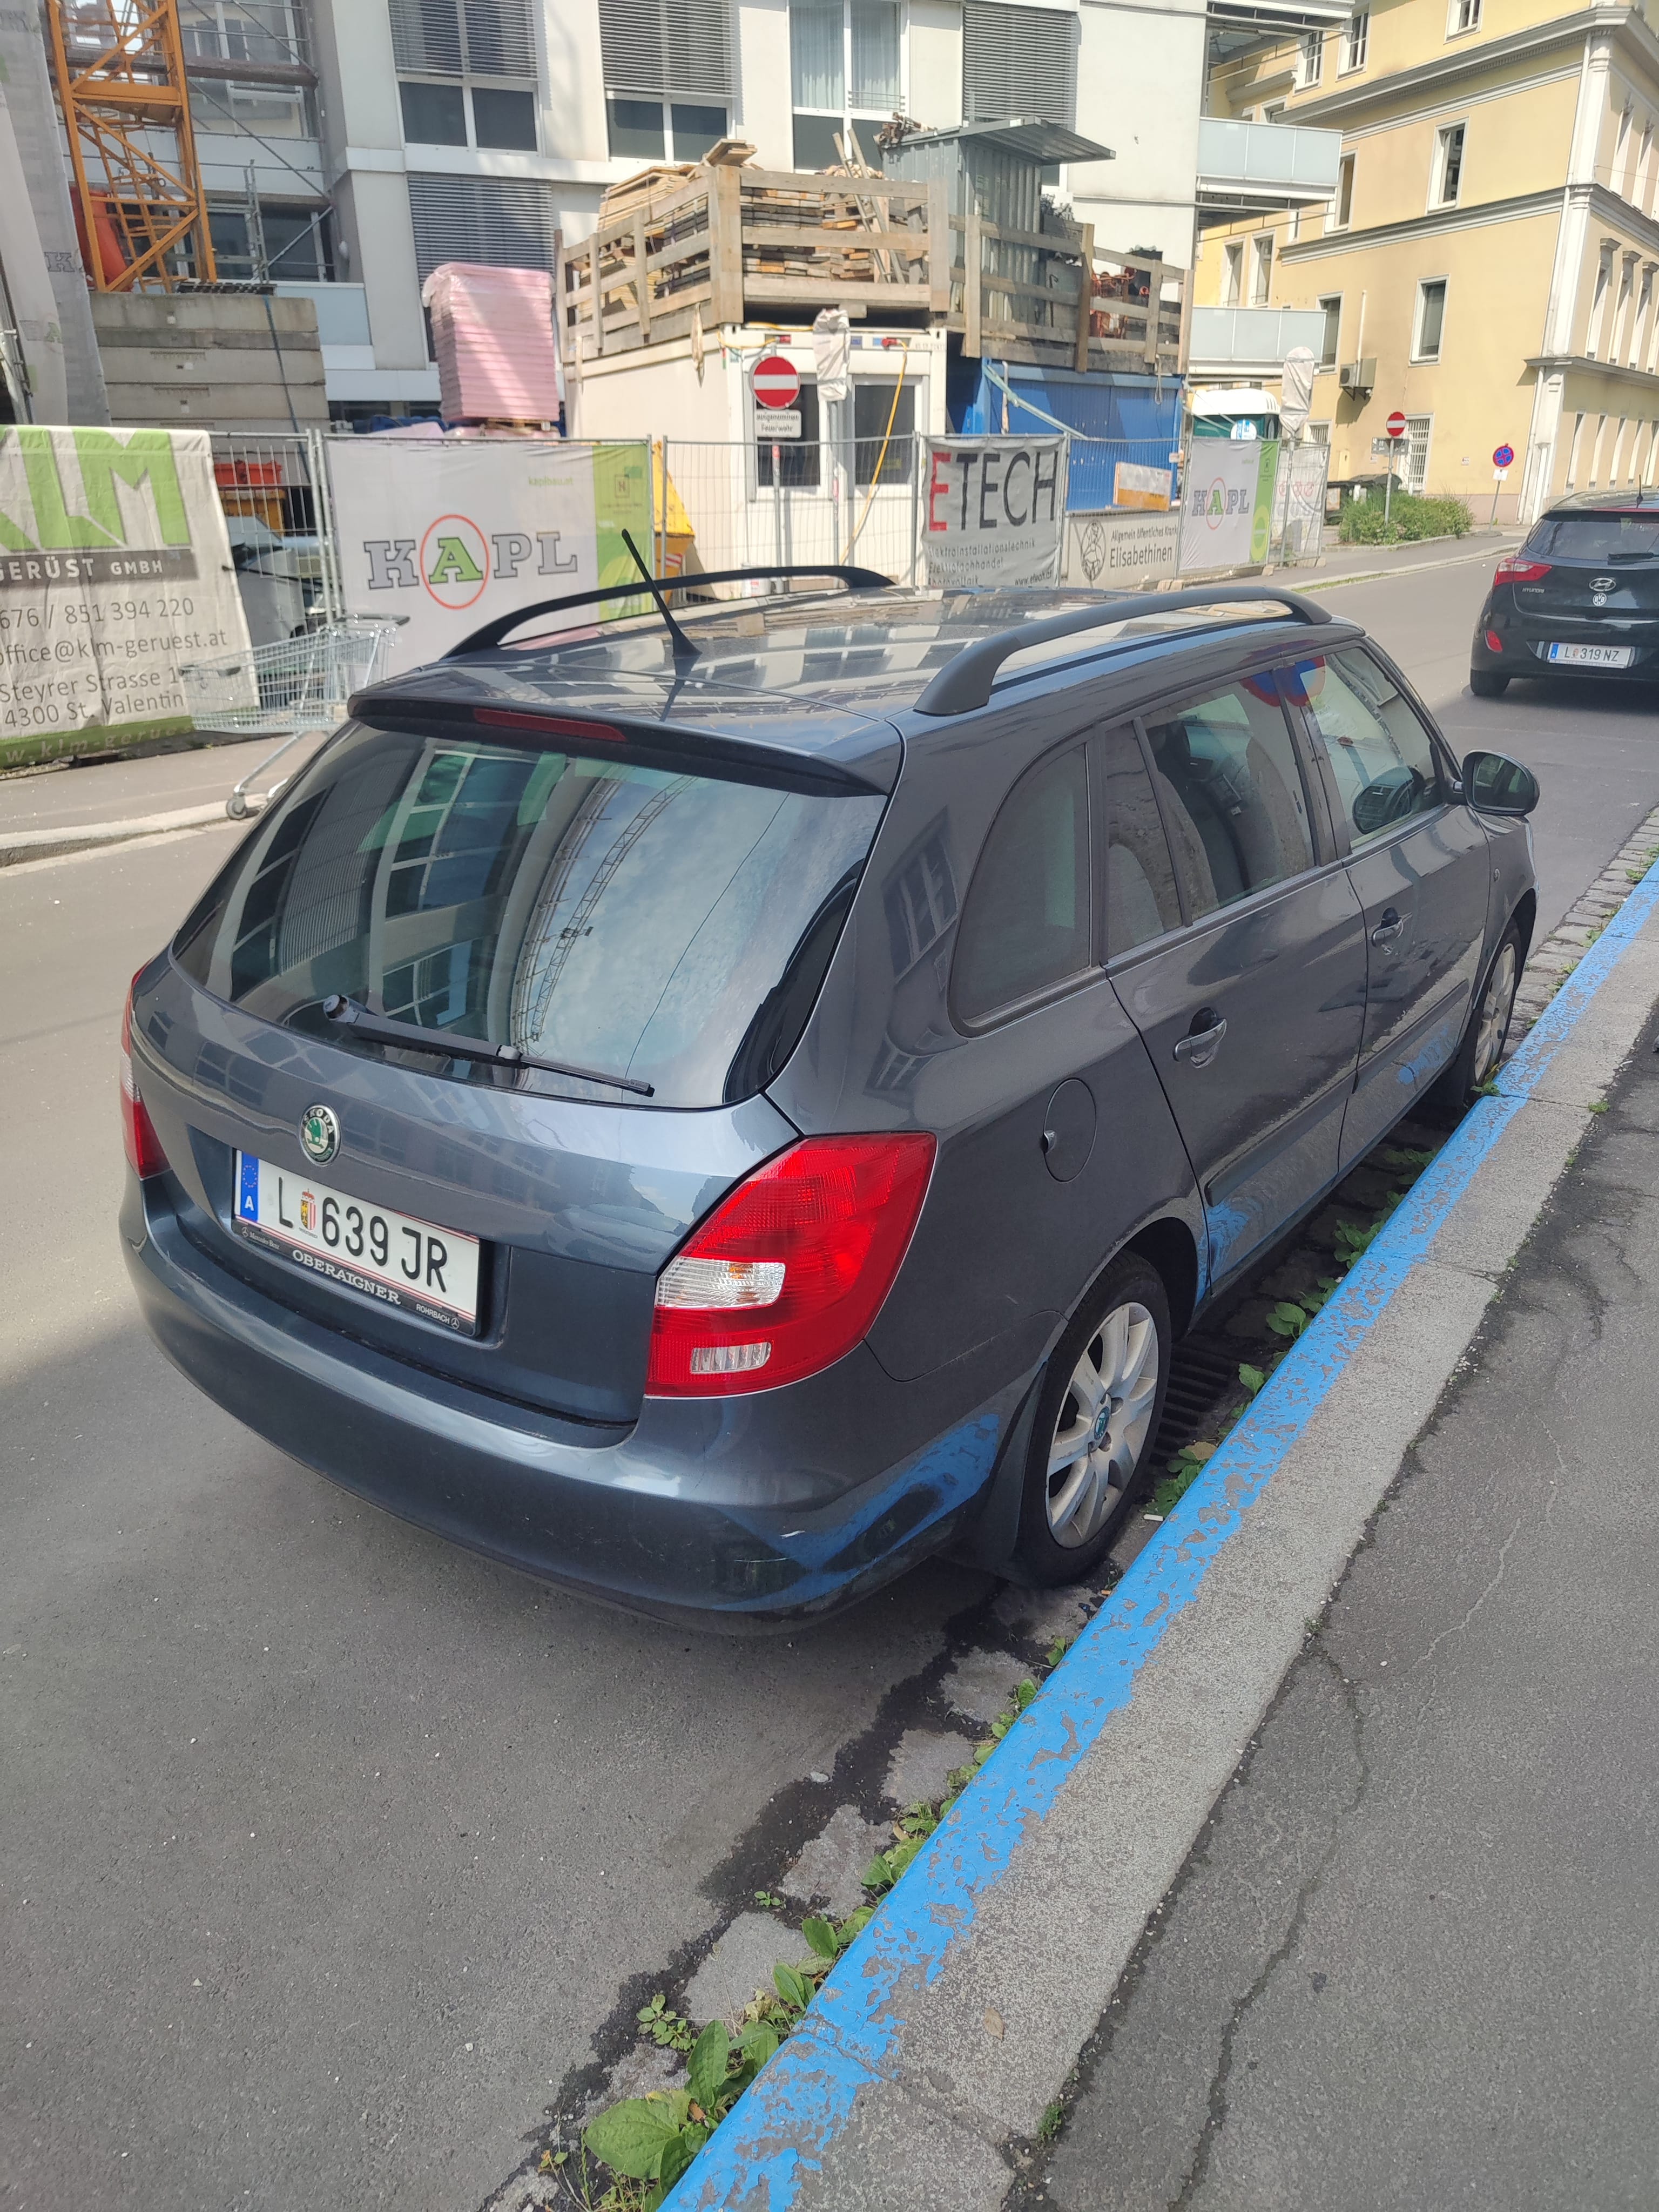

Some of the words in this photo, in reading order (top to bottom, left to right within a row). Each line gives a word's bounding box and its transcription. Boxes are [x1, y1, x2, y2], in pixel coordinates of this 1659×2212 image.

[929, 451, 1058, 531] ETECH
[1192, 489, 1250, 516] KAPL
[1110, 529, 1136, 543] Allgemein
[110, 559, 163, 576] GMBH
[363, 531, 578, 589] KAPL
[1110, 545, 1172, 568] Elisabethinen
[64, 604, 104, 624] 851
[111, 601, 151, 621] 394
[157, 597, 194, 617] 220
[1564, 646, 1570, 658] L
[1580, 648, 1602, 660] 319
[1603, 650, 1620, 662] NZ
[0, 680, 78, 703] Steyrer
[86, 671, 161, 692] Strasse
[5, 705, 59, 727] 4300
[68, 702, 95, 720] St.
[102, 691, 185, 716] Valentin
[244, 1195, 254, 1211] A
[278, 1177, 294, 1229] L
[322, 1197, 389, 1266] 639
[401, 1227, 448, 1293] JR
[293, 1249, 401, 1305] OBERAIGNER
[416, 1303, 450, 1325] ROHRBACH
